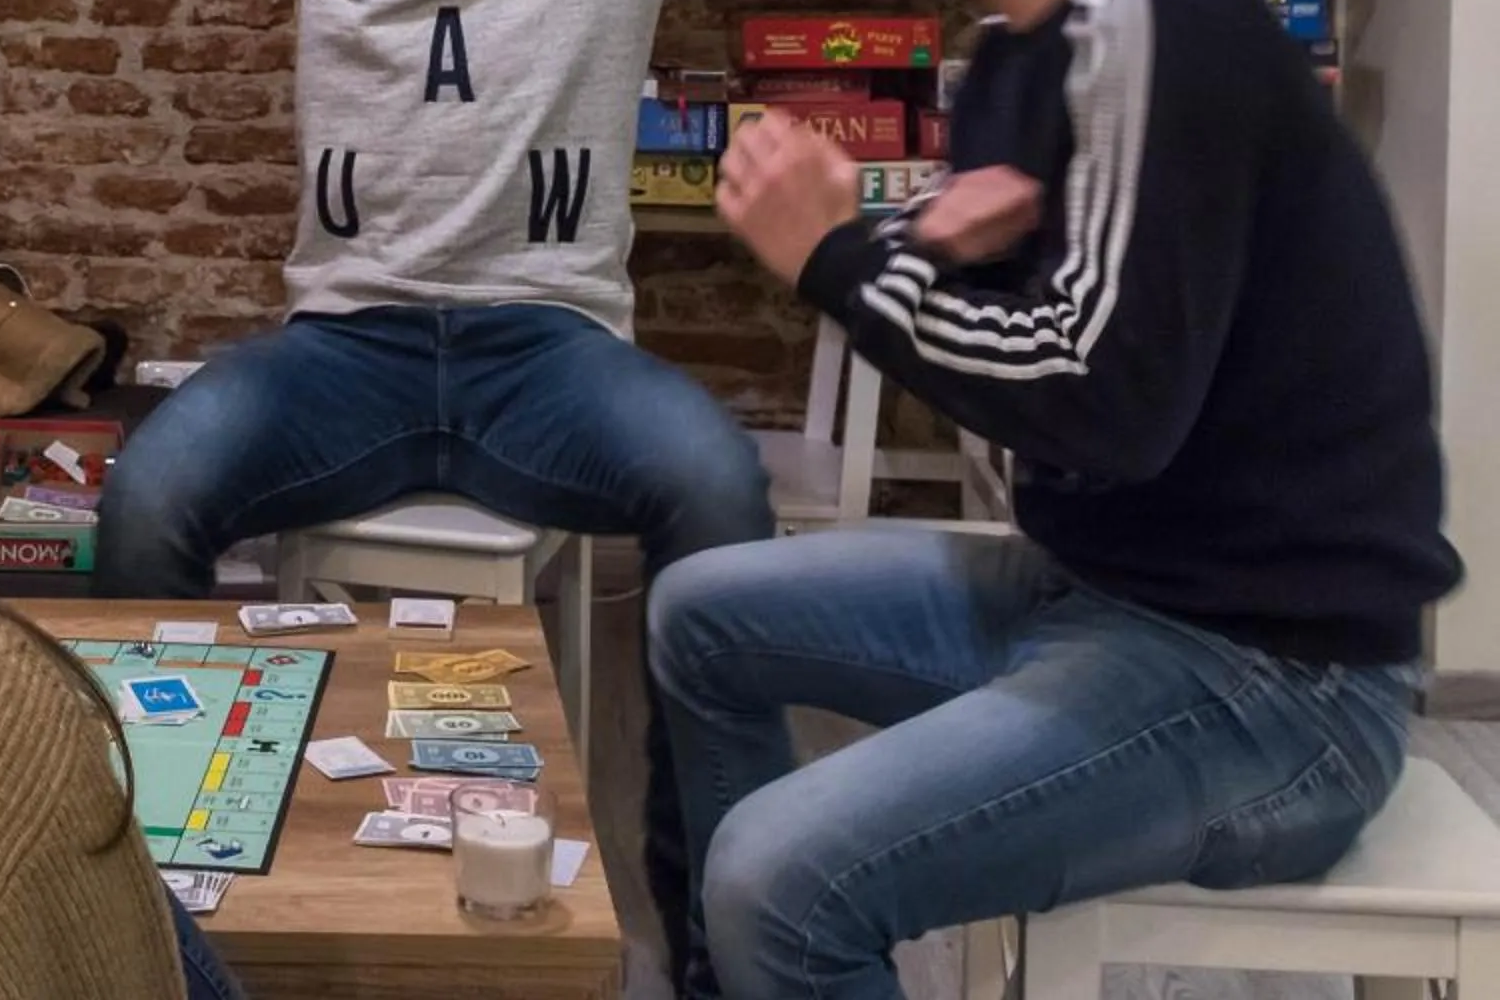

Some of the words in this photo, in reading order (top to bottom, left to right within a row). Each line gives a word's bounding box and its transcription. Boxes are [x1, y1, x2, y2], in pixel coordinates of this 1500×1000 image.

[424, 6, 476, 102] A
[791, 115, 868, 143] ATAN
[316, 148, 360, 239] U
[528, 148, 591, 243] W
[862, 170, 906, 200] FE
